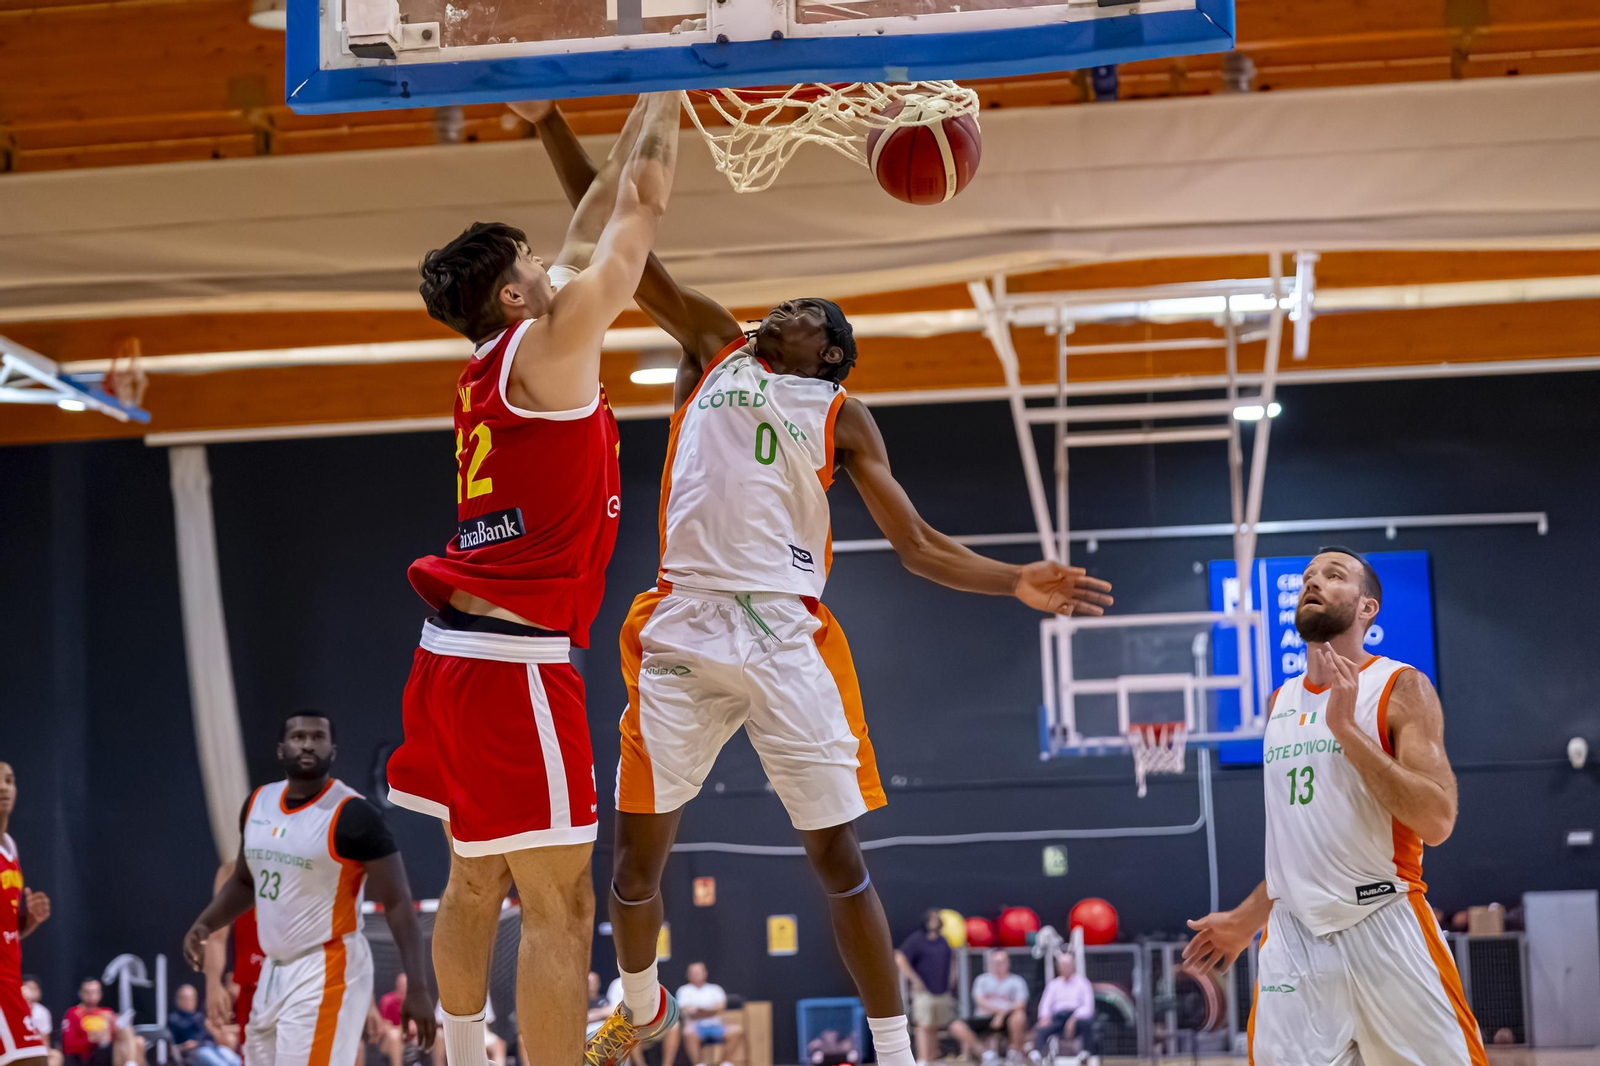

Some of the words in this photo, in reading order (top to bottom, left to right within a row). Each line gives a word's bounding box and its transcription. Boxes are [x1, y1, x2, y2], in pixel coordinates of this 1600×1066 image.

[698, 389, 750, 410] CÔTE
[754, 422, 778, 465] 0
[457, 514, 521, 549] aixaBank
[644, 667, 679, 676] NUBA
[1264, 744, 1292, 764] ÔTE
[1293, 739, 1348, 758] D'IVOIR
[1286, 765, 1315, 806] 13
[258, 869, 282, 901] 23
[1359, 887, 1384, 897] NUBA
